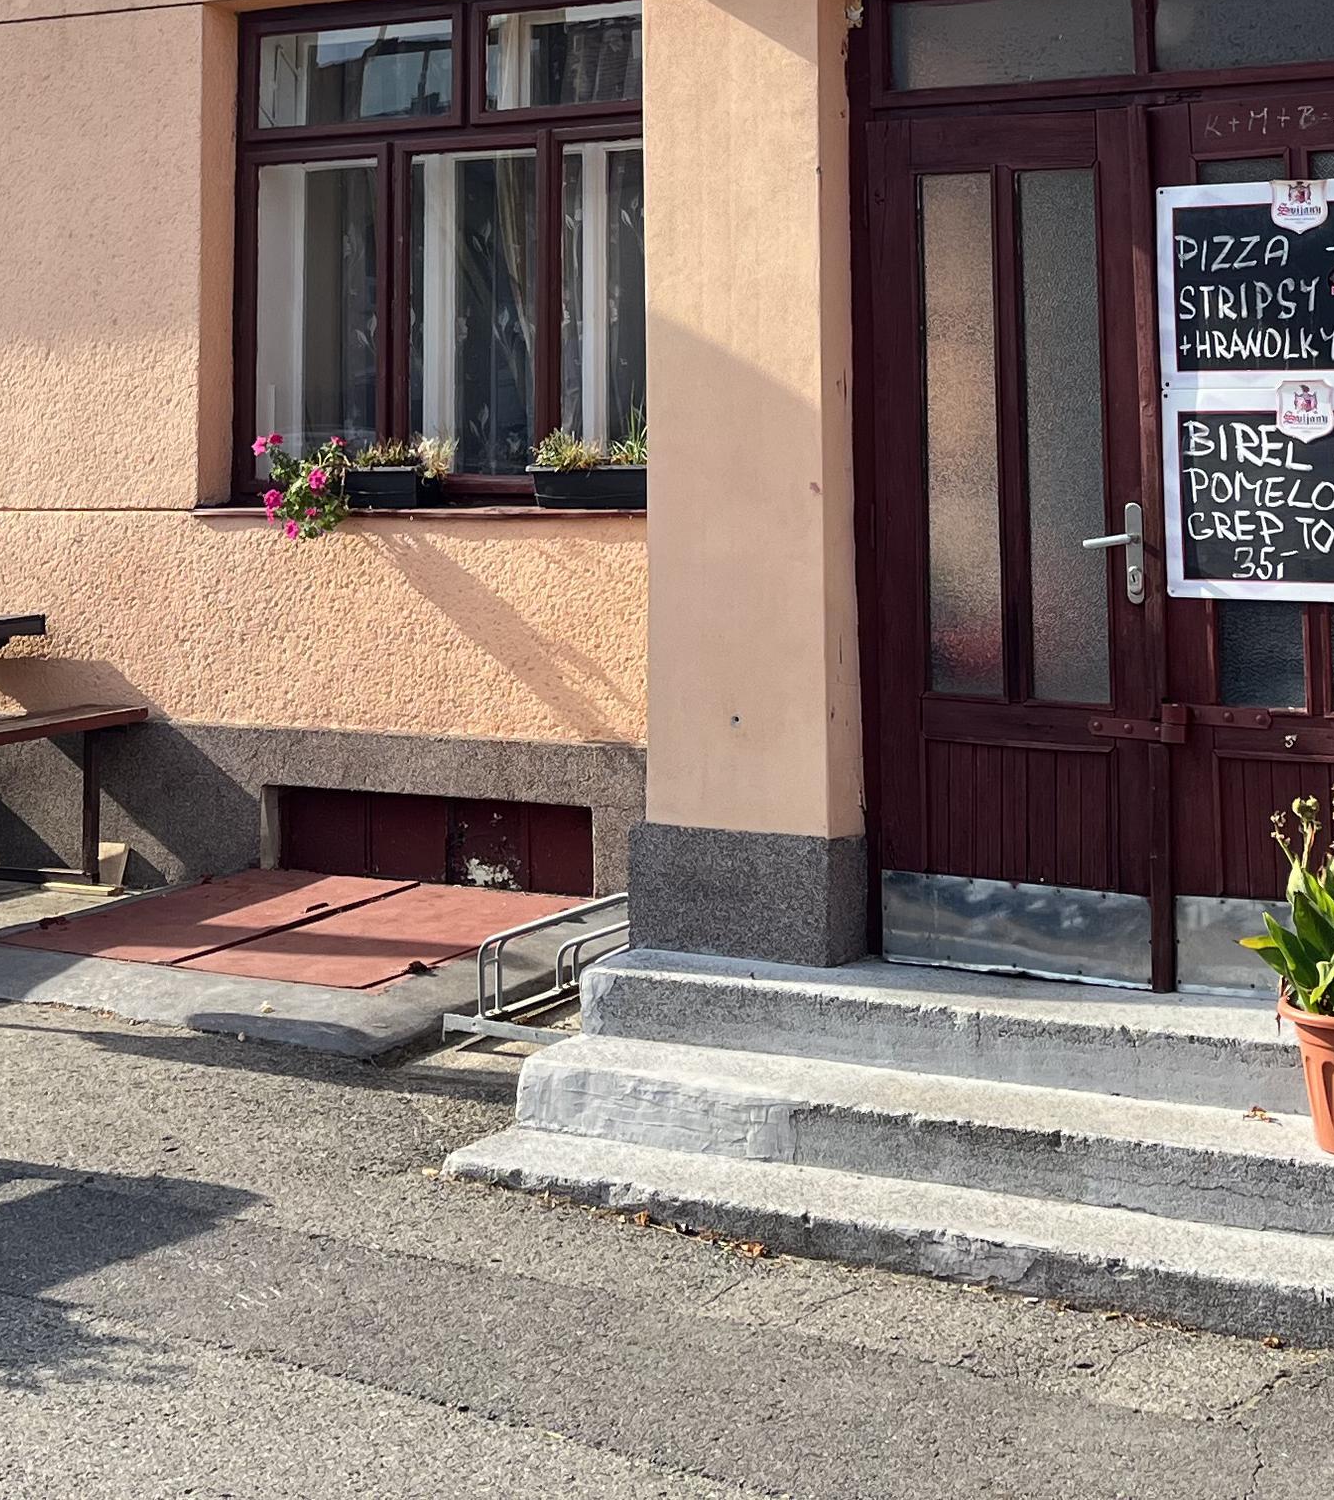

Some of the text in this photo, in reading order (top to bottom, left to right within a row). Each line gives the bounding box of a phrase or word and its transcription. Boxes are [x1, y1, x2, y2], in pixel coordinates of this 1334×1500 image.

[1277, 202, 1322, 216] Svijany
[1175, 235, 1290, 272] PIZZA
[1178, 276, 1320, 320] STRIPSY
[1283, 411, 1328, 425] Svijany
[1183, 420, 1313, 471] BIREL
[1187, 510, 1284, 545] GREP
